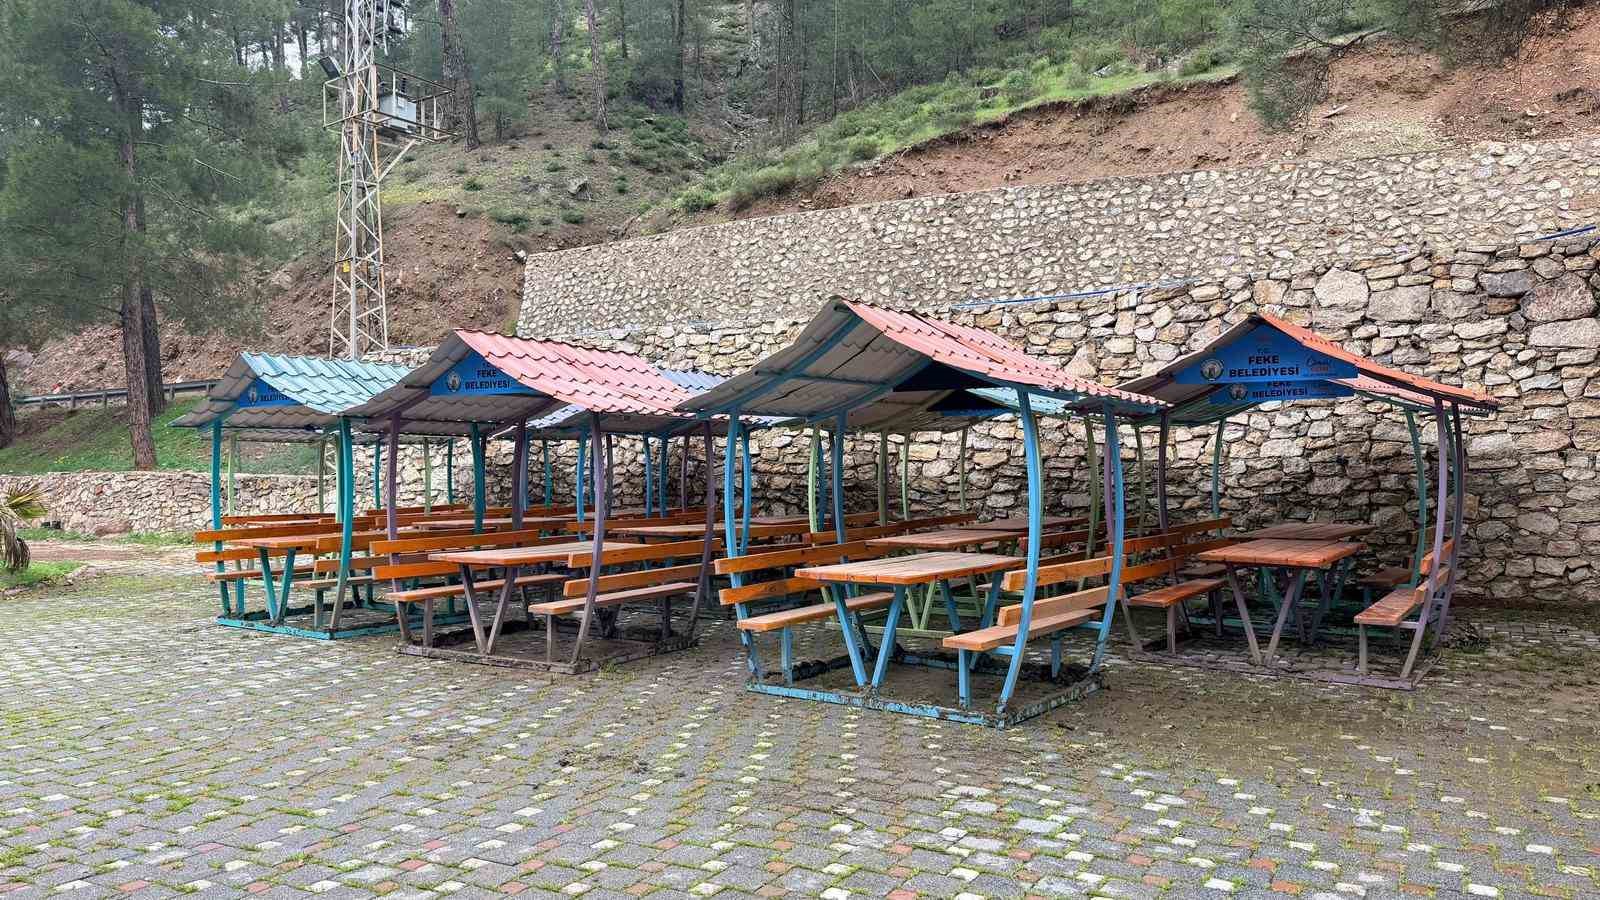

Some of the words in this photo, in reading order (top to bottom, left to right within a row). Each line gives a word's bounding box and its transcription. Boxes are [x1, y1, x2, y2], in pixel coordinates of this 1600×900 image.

[1248, 355, 1280, 365] FEKE
[475, 369, 497, 378] FEKE
[1229, 363, 1300, 378] BELEDİYESİ
